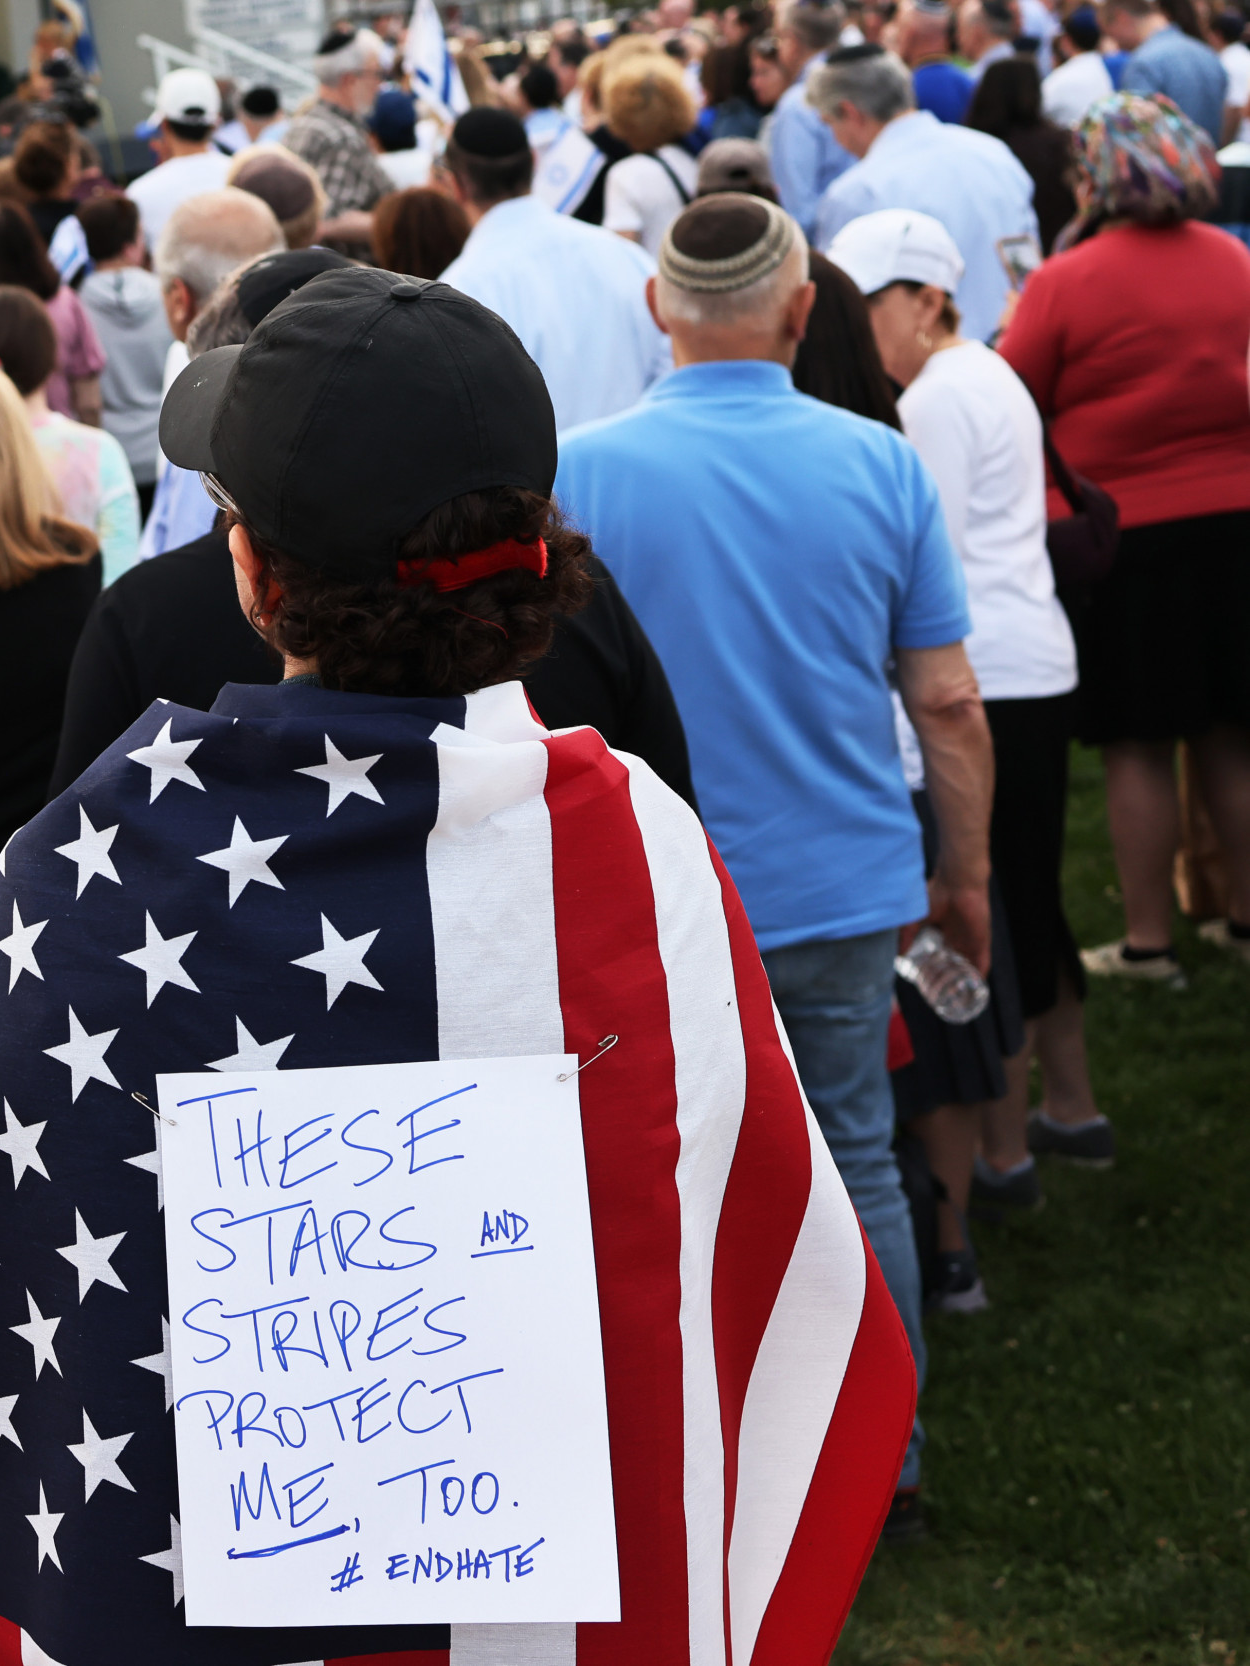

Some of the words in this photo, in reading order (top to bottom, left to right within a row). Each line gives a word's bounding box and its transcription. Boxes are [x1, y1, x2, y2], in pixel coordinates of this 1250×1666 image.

[176, 1083, 478, 1189] THESE
[189, 1199, 438, 1285] STARS
[479, 1208, 531, 1247] AND
[182, 1287, 467, 1373] STRIPES
[175, 1367, 505, 1451] PROTECT
[230, 1461, 362, 1534] ME,
[377, 1458, 520, 1525] TOO.
